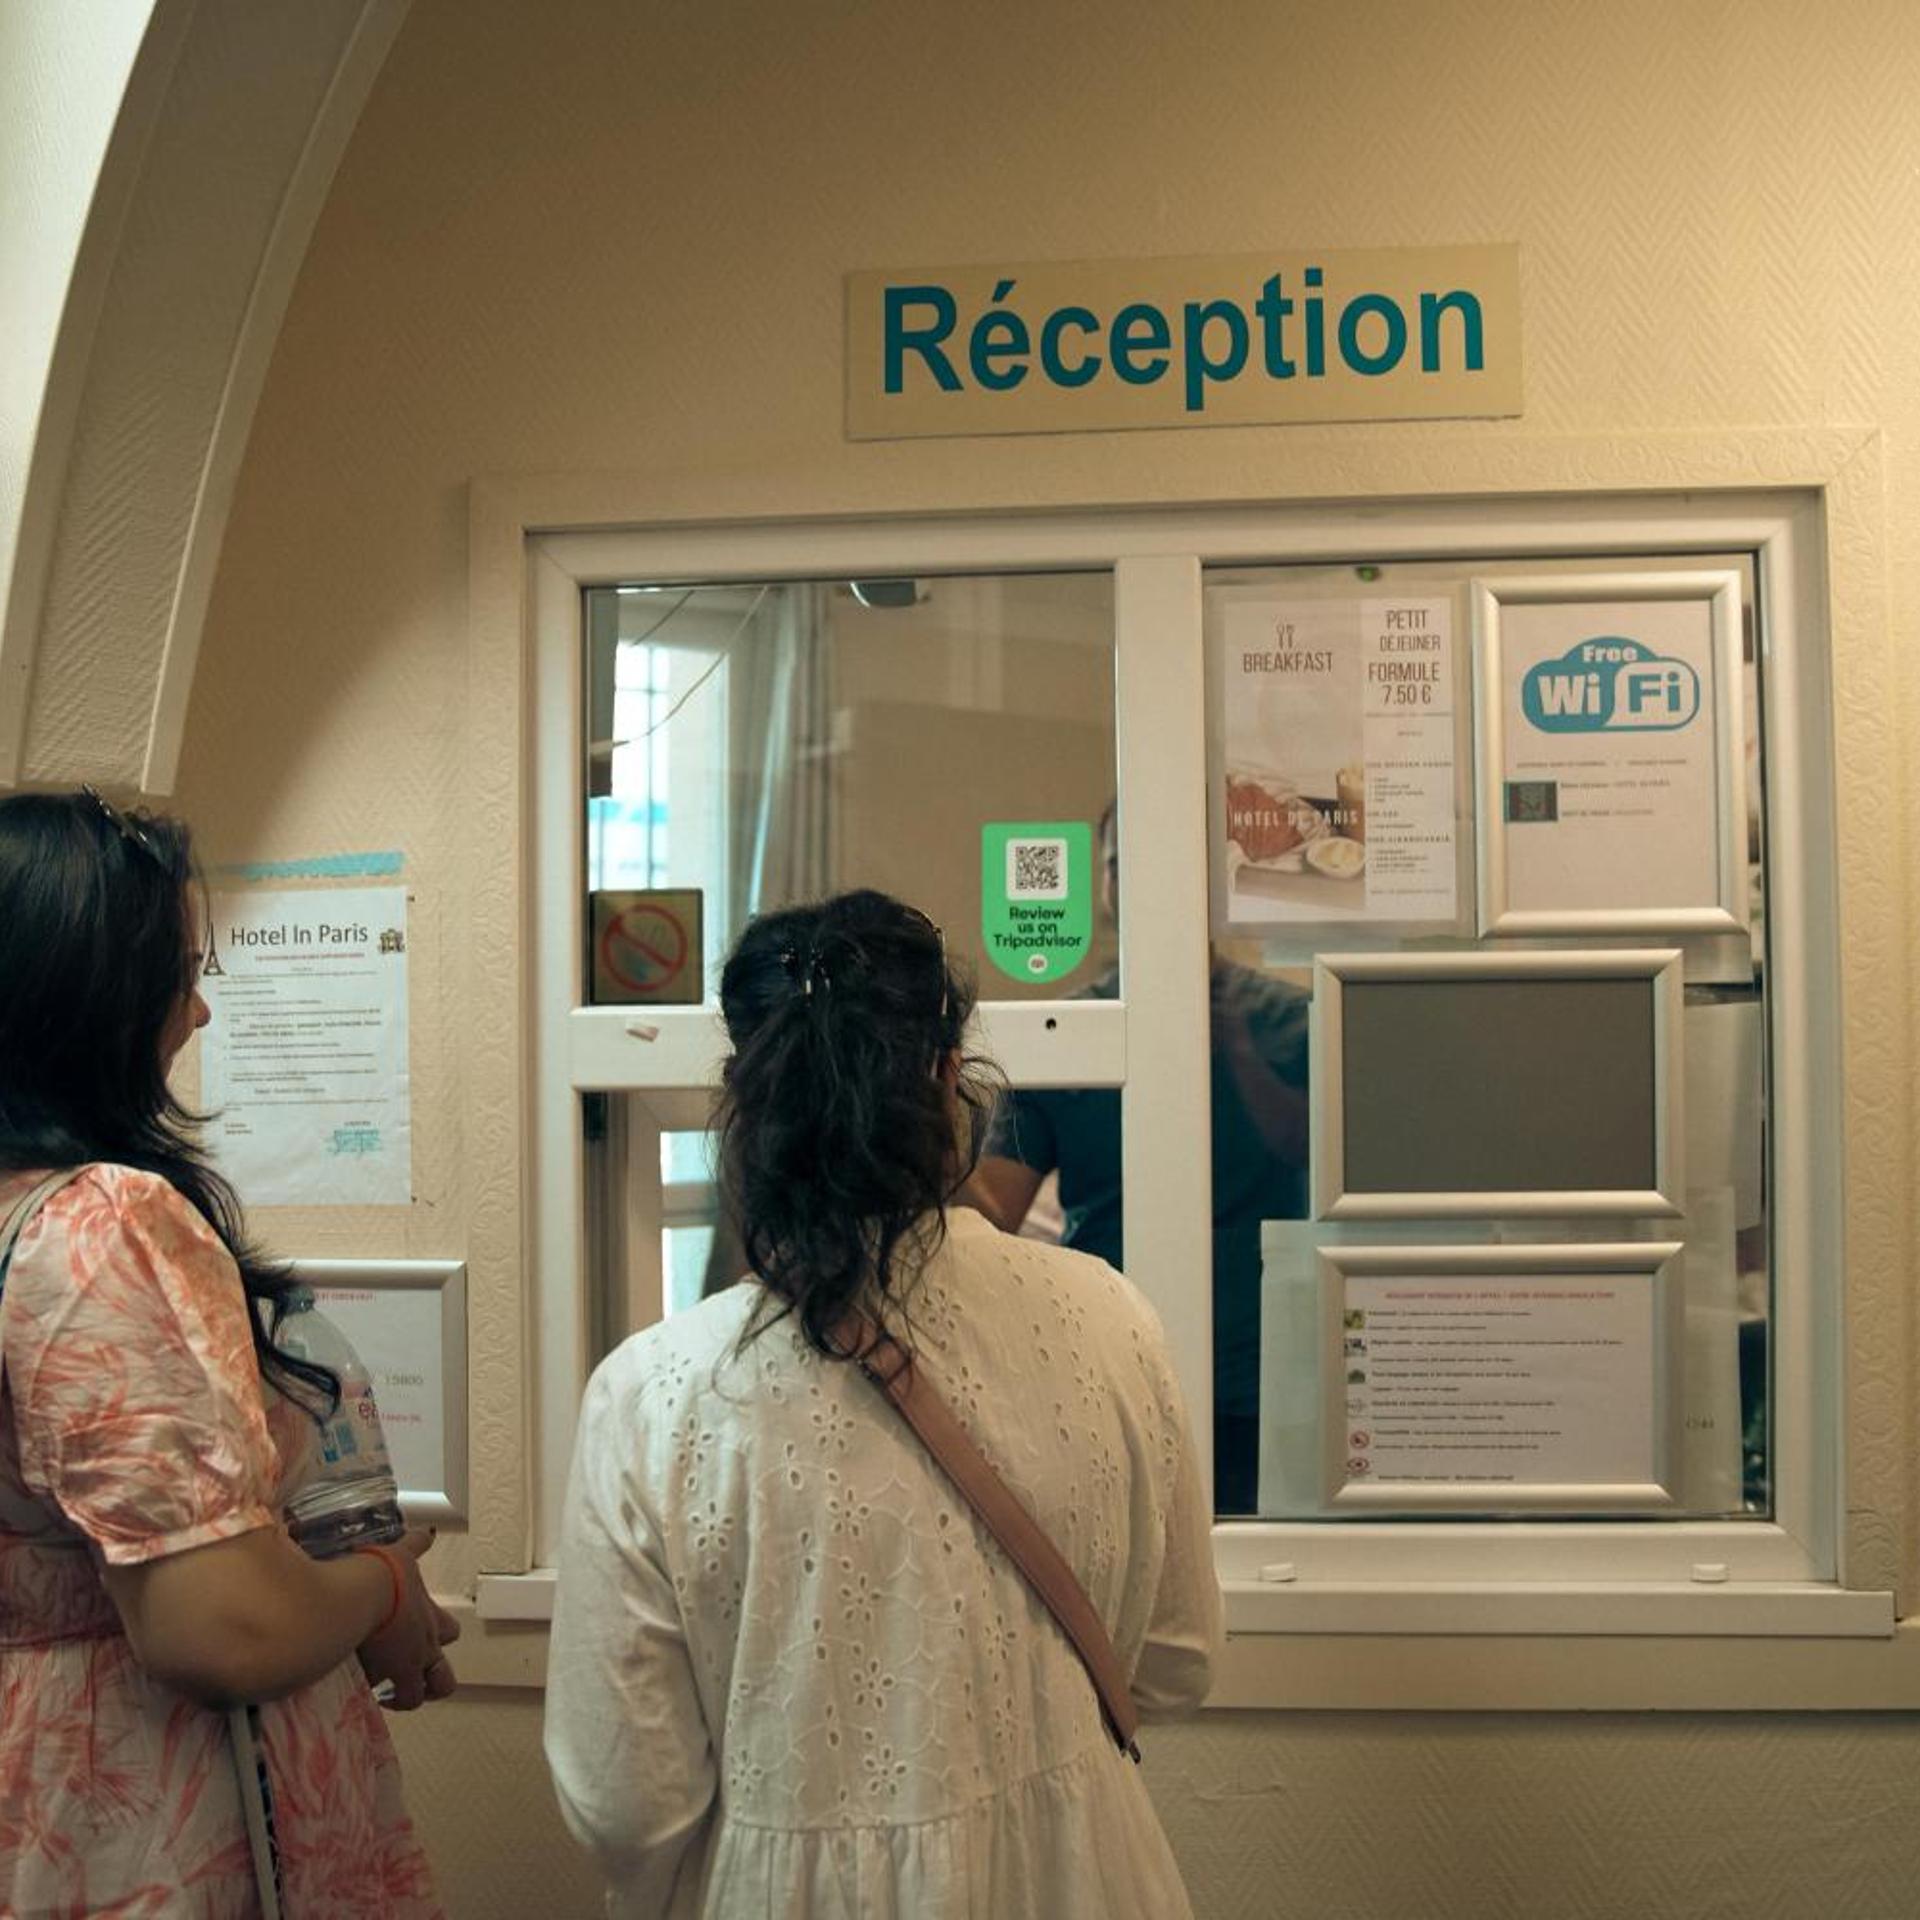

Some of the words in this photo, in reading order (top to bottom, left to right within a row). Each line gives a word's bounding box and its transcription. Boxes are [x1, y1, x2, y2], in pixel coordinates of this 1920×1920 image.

[883, 267, 1484, 411] Réception
[1385, 609, 1430, 629] PETIT
[1243, 652, 1333, 673] BREAKFAST
[1582, 645, 1638, 662] Free
[1368, 662, 1440, 682] FORMULE
[1382, 684, 1417, 705] 7.50
[1233, 810, 1280, 827] HOTEL
[1009, 906, 1066, 921] Review
[231, 925, 286, 946] Hotel
[293, 925, 311, 945] In
[318, 923, 369, 945] Paris
[1017, 923, 1034, 934] us
[1038, 923, 1058, 934] on
[994, 933, 1083, 950] Tripadvisor
